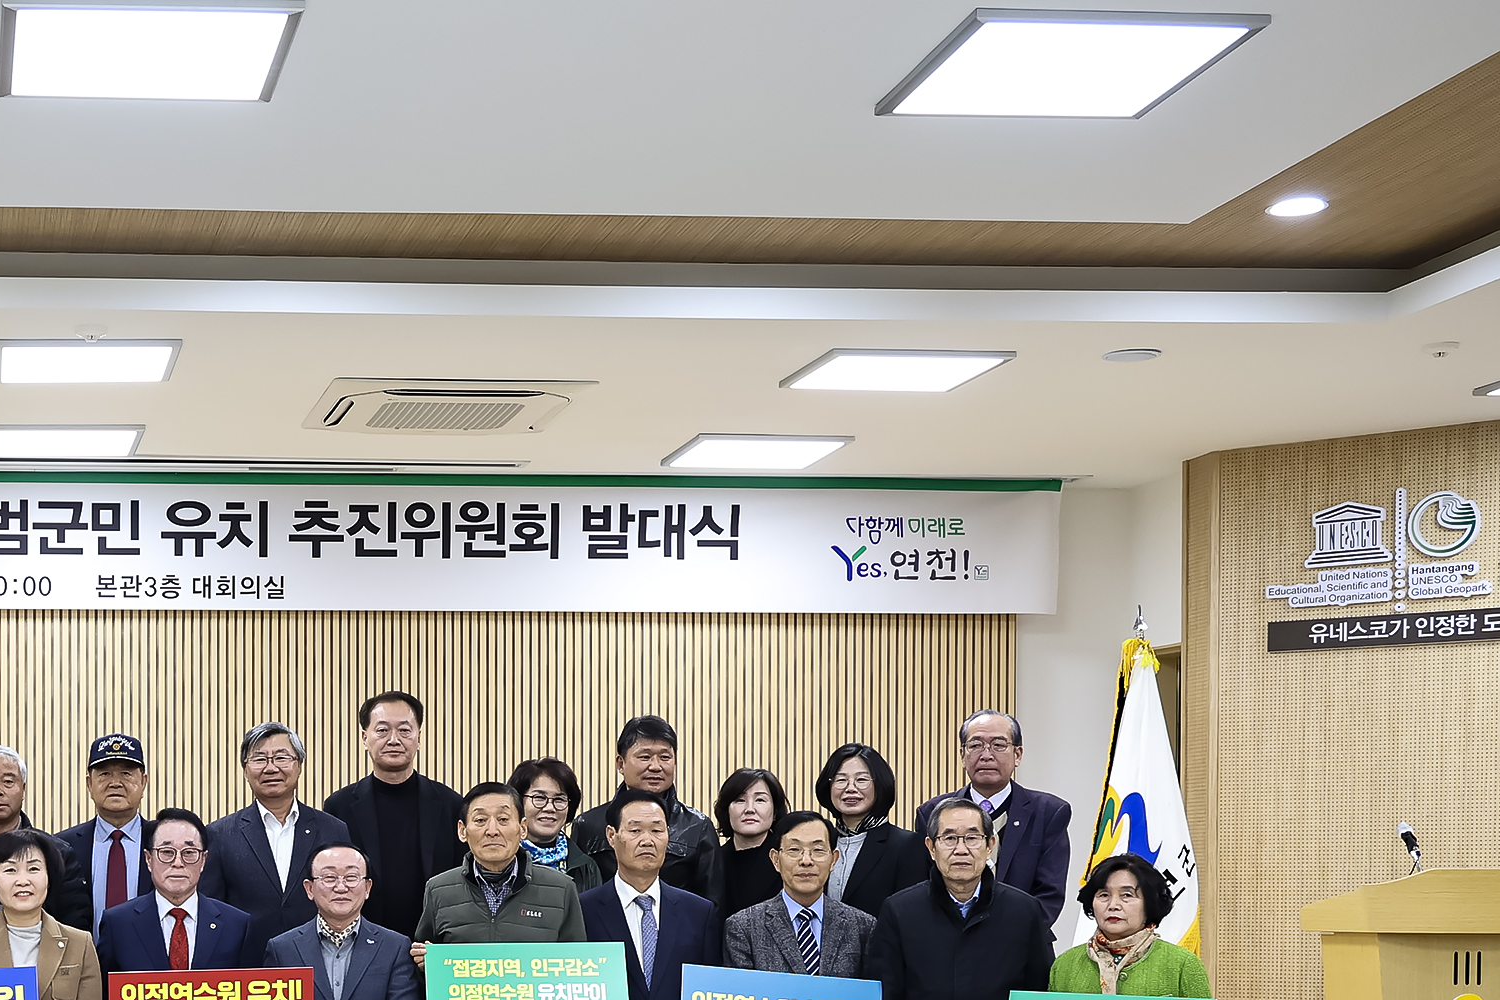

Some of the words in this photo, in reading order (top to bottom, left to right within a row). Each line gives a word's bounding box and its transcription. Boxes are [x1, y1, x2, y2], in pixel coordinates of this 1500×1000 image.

[161, 500, 269, 558] 유치
[288, 500, 560, 560] 추진위원회
[581, 503, 741, 561] 발대식
[846, 516, 904, 545] 다함께
[908, 517, 966, 538] 미래로
[1318, 520, 1378, 551] UNESCO
[831, 545, 888, 582] Yes,
[890, 548, 970, 581] 연천!
[1411, 563, 1475, 576] Hantangang
[1320, 571, 1350, 582] United
[1352, 570, 1388, 580] Nations
[1411, 574, 1458, 586] UNESCO
[95, 574, 182, 600] 본관3층
[191, 574, 286, 600] 대회의실
[1268, 585, 1325, 597] Educational,
[1326, 582, 1369, 593] Scientific
[1370, 580, 1388, 589] and
[1411, 586, 1443, 597] Global
[1445, 583, 1488, 596] Geopark
[1291, 595, 1327, 605] Cultural
[1328, 591, 1388, 604] Organization
[1309, 621, 1410, 644] 유네스코가
[1415, 613, 1478, 638] 인정한
